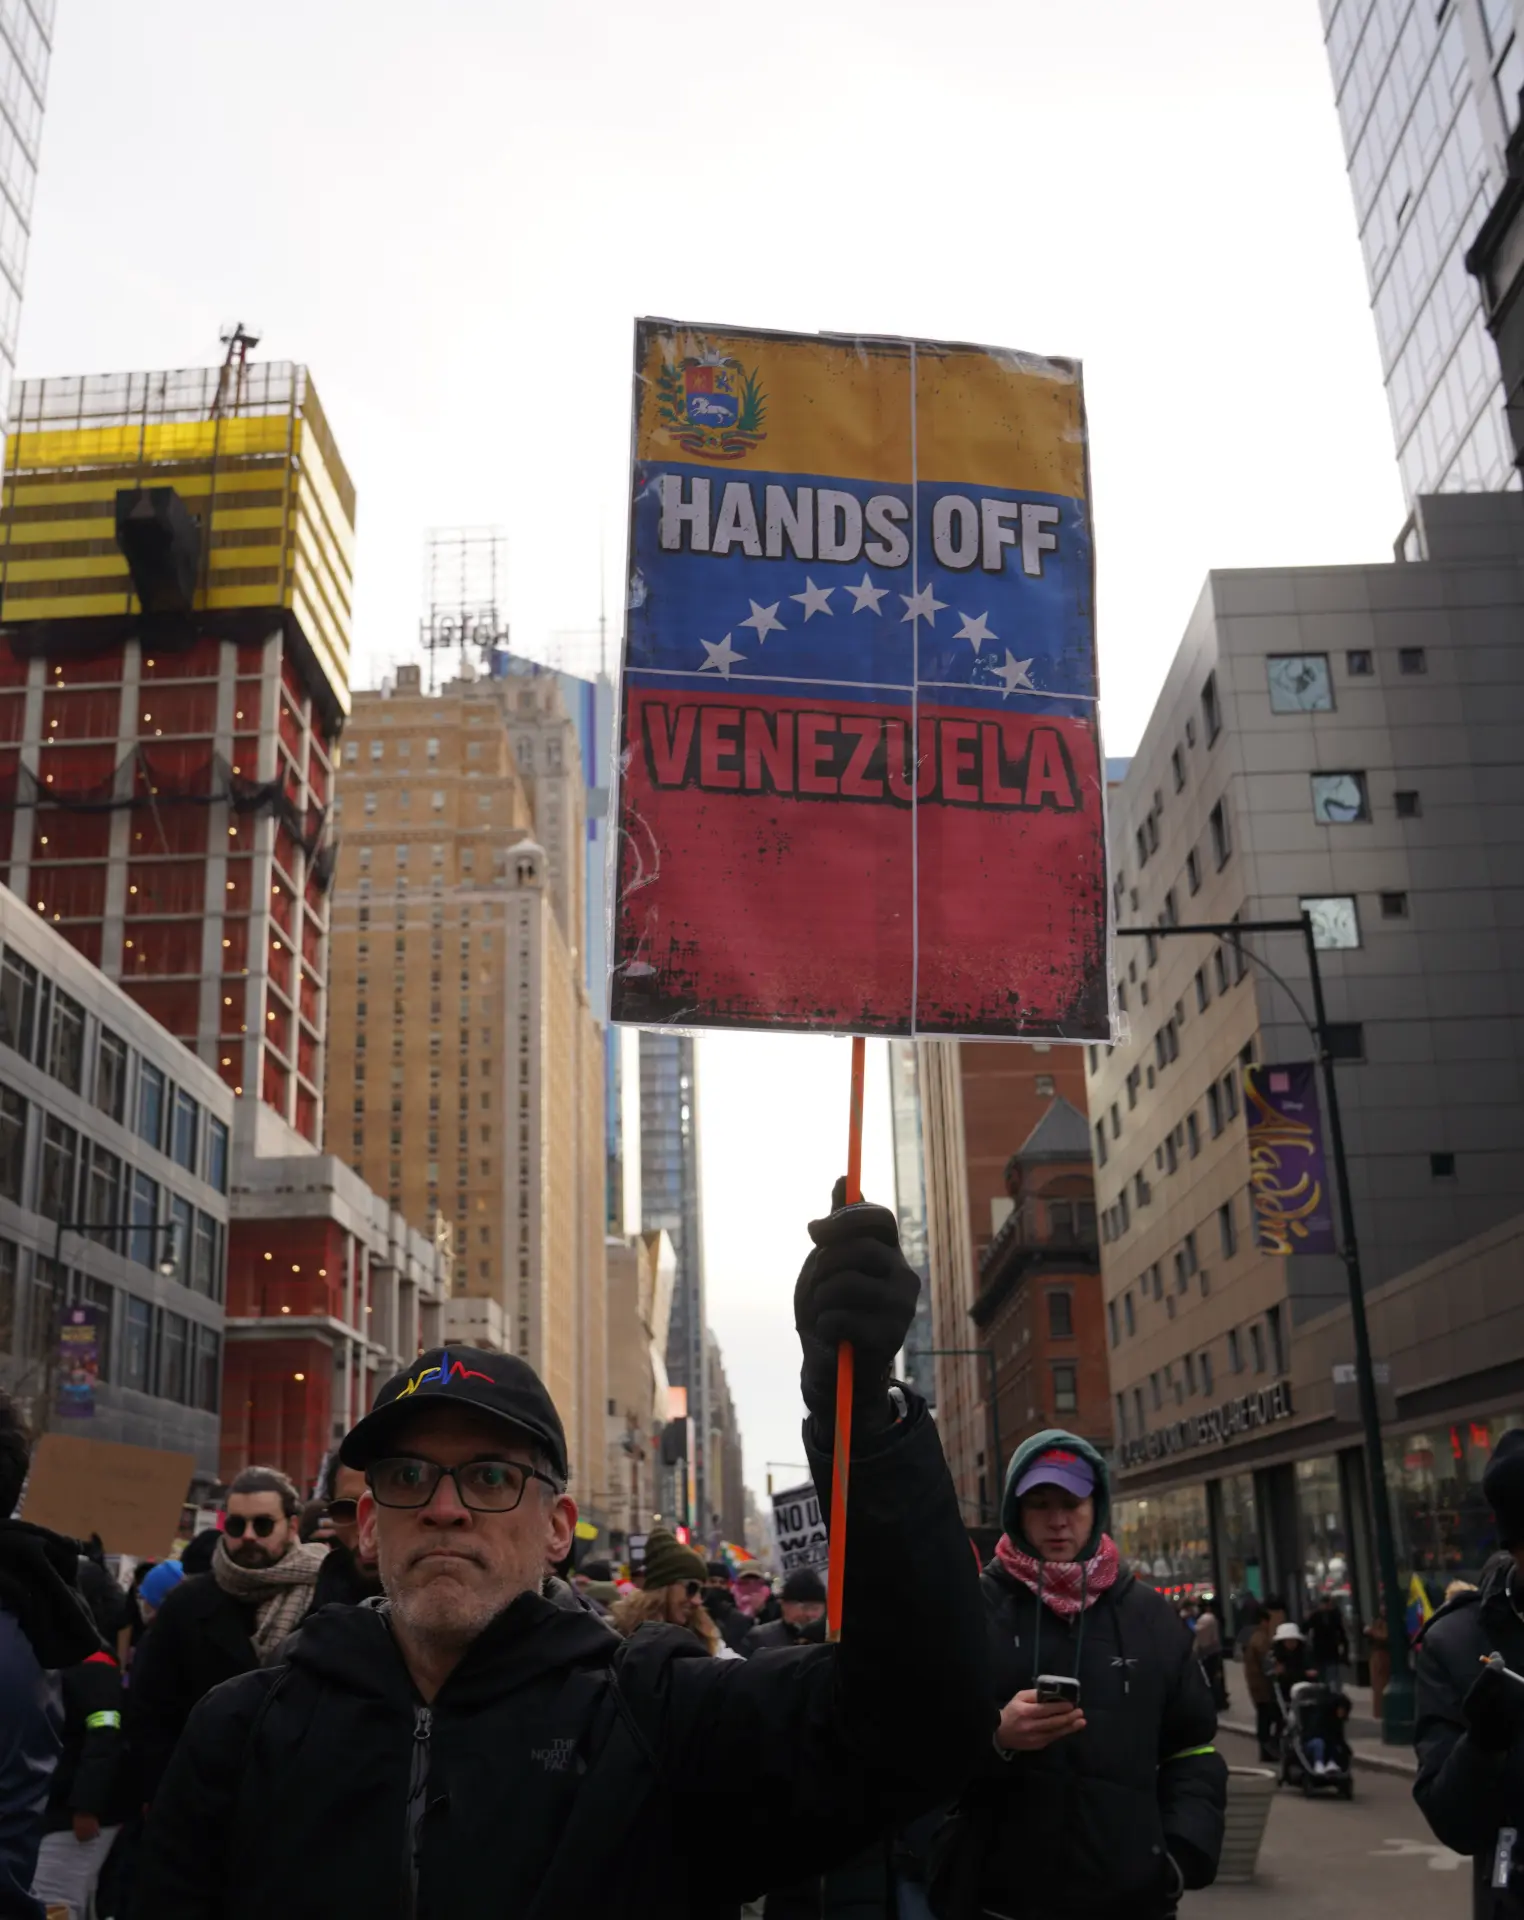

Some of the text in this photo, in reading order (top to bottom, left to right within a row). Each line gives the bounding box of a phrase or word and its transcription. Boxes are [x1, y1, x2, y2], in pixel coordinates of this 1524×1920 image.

[660, 474, 1060, 577] HANDS OFF
[643, 702, 1078, 809] VENEZUELA
[775, 1498, 820, 1535] NO U
[779, 1531, 826, 1552] WA
[544, 1760, 569, 1772] FAC
